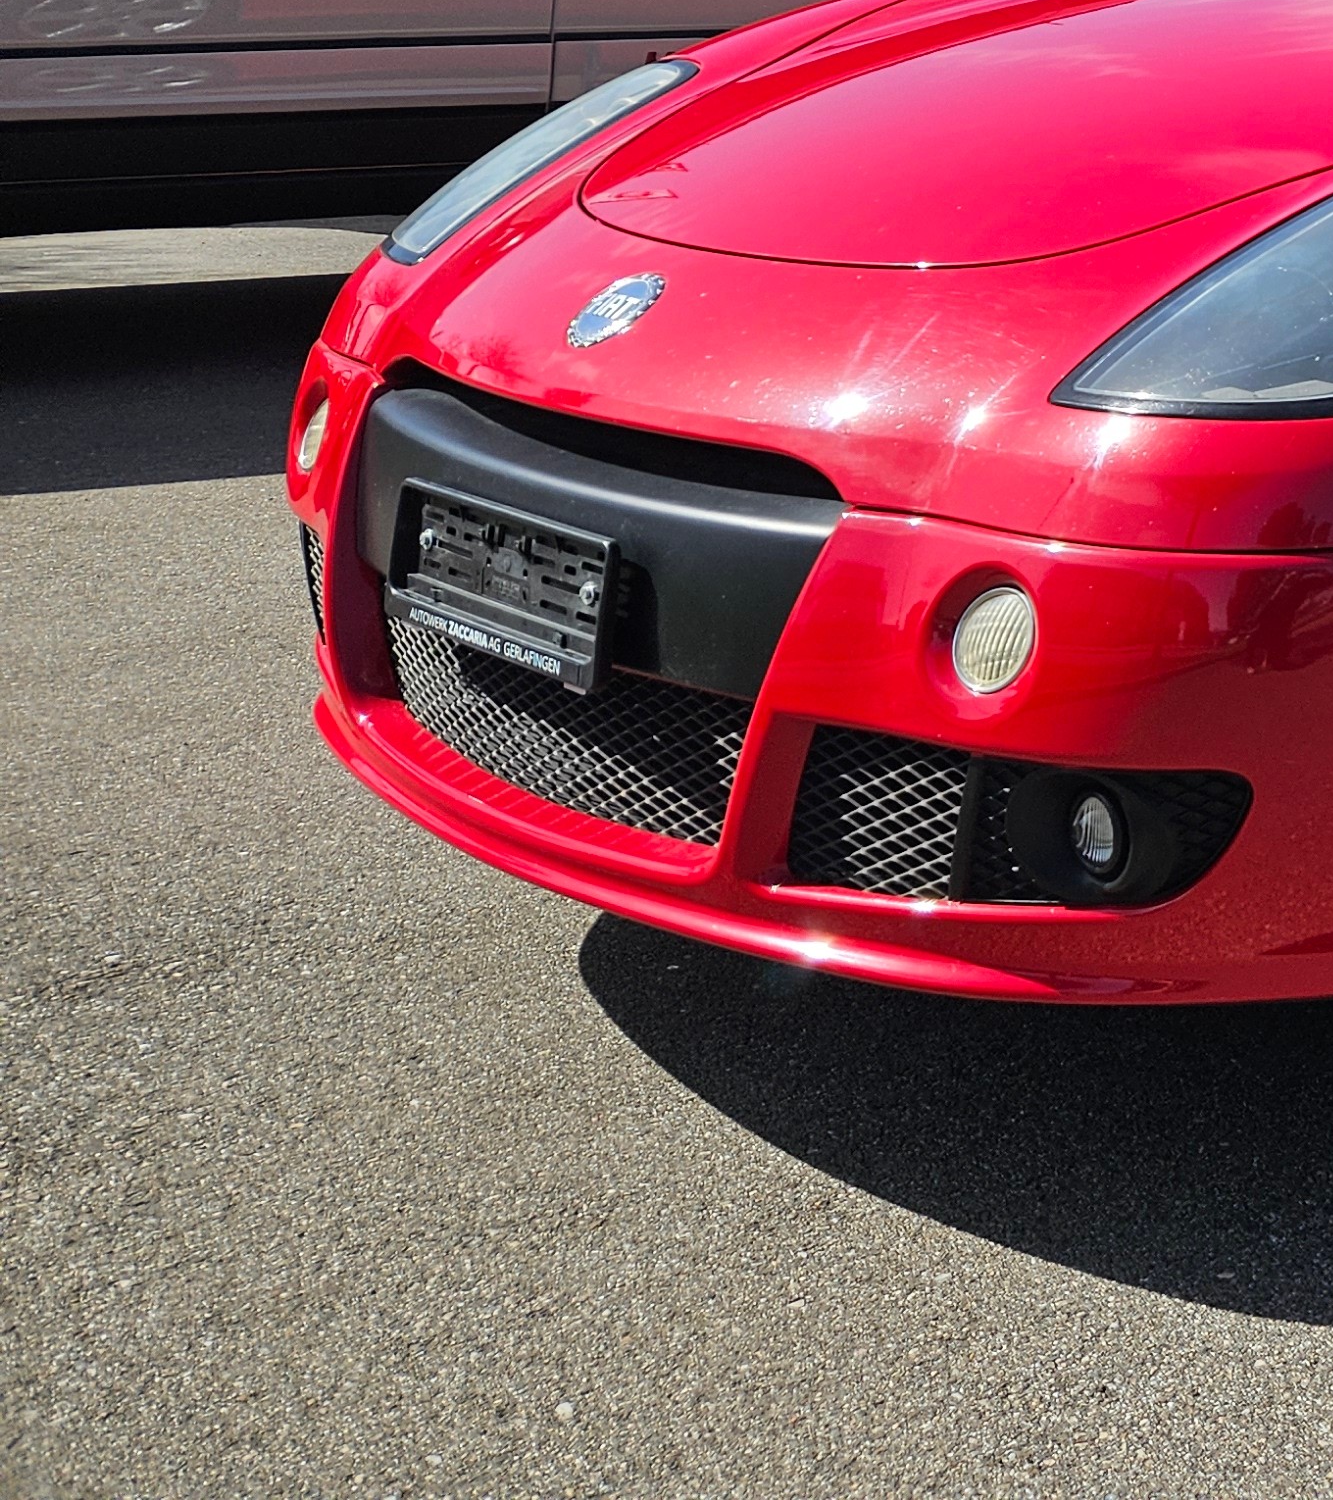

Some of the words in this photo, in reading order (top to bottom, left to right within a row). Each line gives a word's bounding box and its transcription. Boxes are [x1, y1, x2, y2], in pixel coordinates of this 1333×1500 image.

[585, 292, 641, 320] FIAT
[409, 607, 448, 632] AUTOWERK
[447, 619, 489, 648] ZACCARIA
[488, 635, 501, 653] AG
[503, 641, 561, 676] GERLAFINGEN
